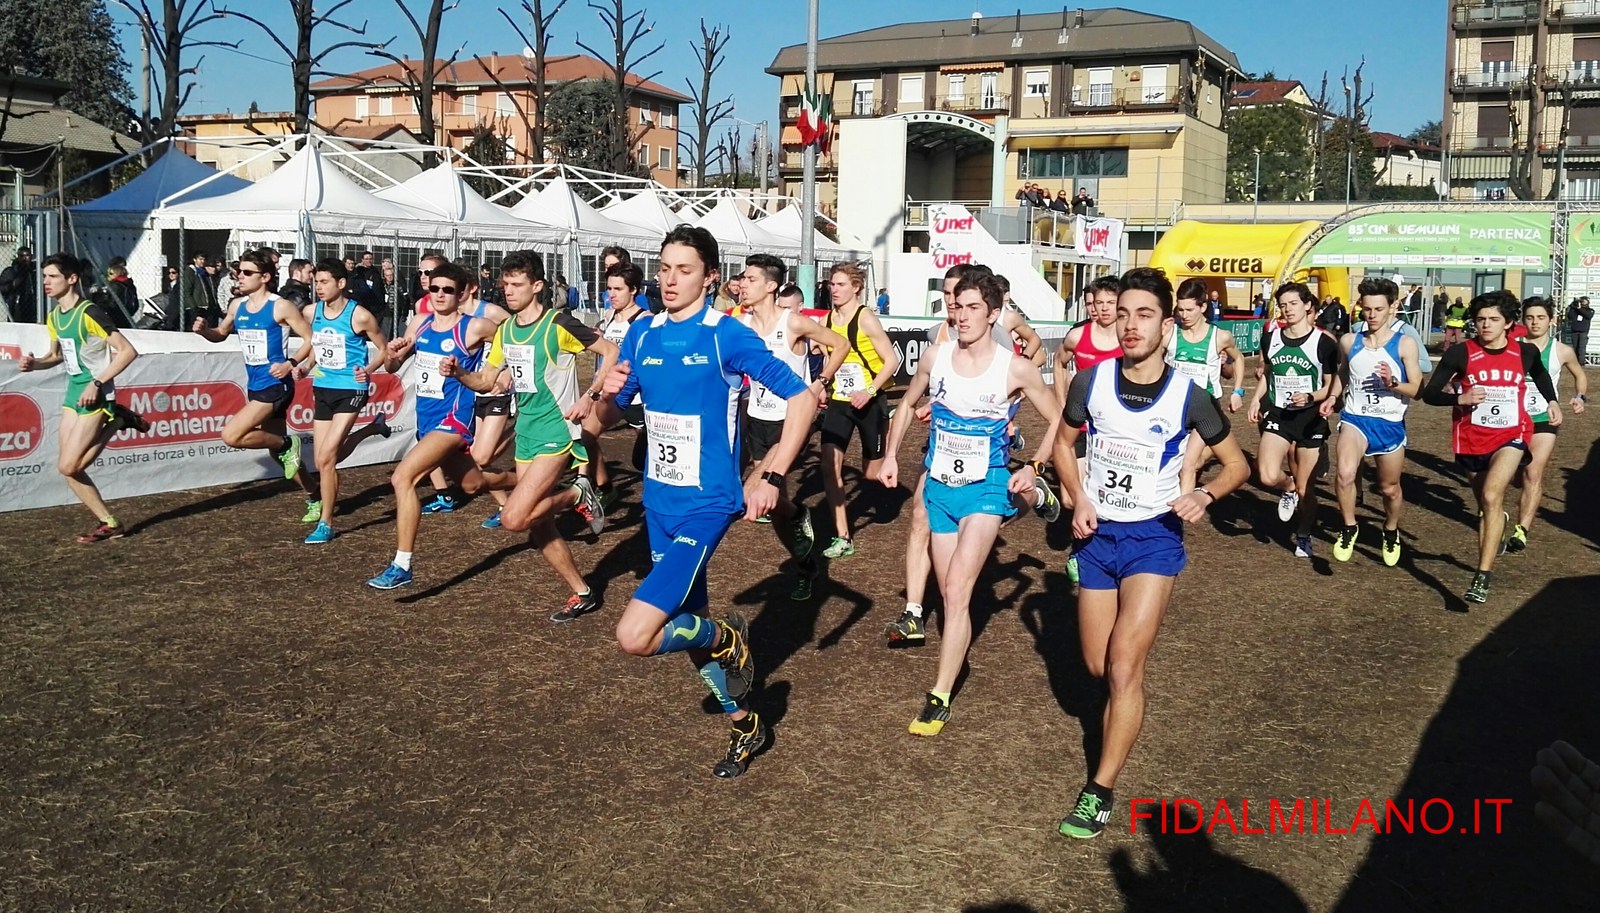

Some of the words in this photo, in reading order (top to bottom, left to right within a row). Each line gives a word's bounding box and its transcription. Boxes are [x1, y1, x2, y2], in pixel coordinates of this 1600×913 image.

[1470, 228, 1541, 240] PARTENZA
[322, 348, 334, 358] 29
[1270, 355, 1313, 371] RICCARDI
[422, 372, 429, 383] 9
[512, 366, 523, 378] 15
[843, 378, 855, 388] 28
[759, 388, 766, 398] 7
[1365, 394, 1380, 405] 13
[1491, 405, 1500, 415] 6
[109, 452, 149, 465] nostra
[154, 449, 185, 461] forza
[188, 446, 196, 457] è
[199, 446, 205, 456] il
[658, 443, 677, 464] 33
[953, 459, 964, 474] 8
[661, 466, 684, 481] Gallo
[948, 474, 974, 485] Gallo
[1104, 469, 1133, 493] 34
[1105, 493, 1137, 509] Gallo
